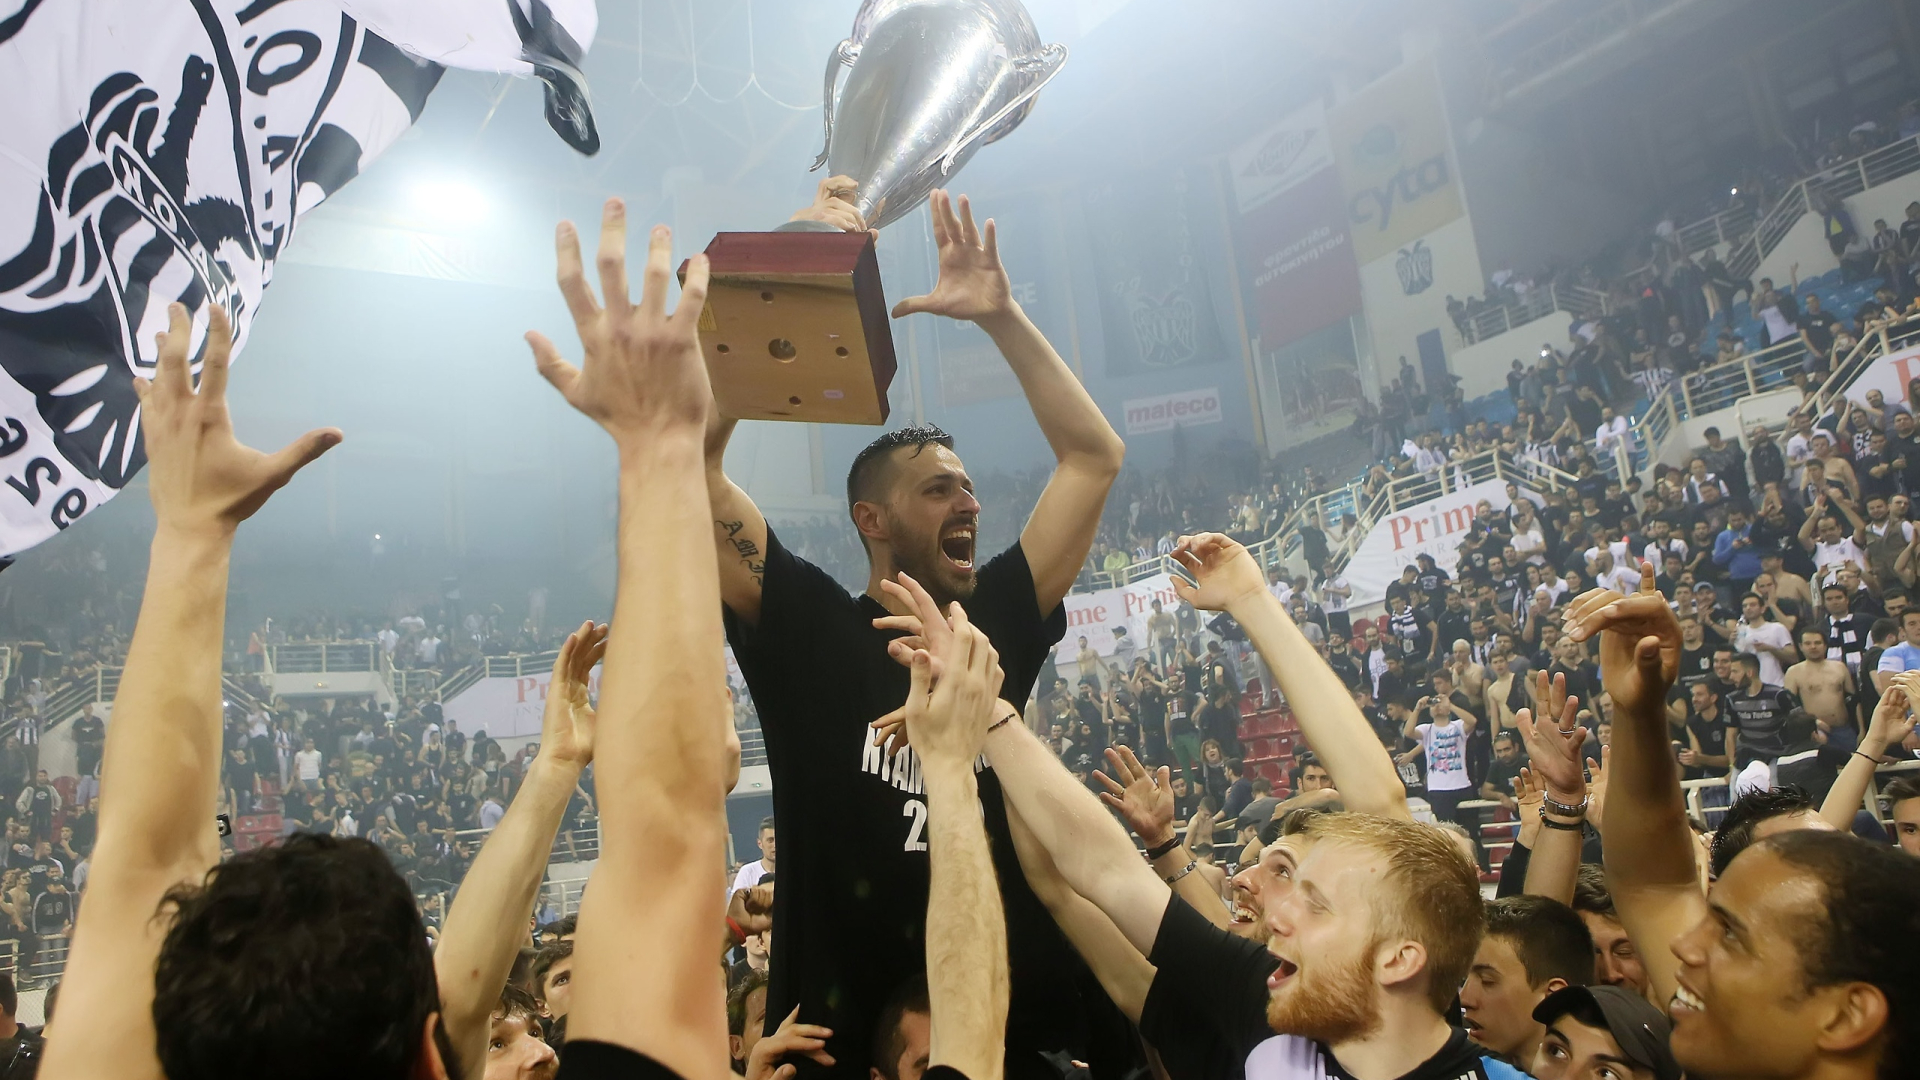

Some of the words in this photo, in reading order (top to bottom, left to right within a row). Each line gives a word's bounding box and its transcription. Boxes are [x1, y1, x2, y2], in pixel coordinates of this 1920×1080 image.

[1348, 153, 1449, 231] cyta
[1127, 396, 1218, 423] mateco
[1388, 504, 1478, 552] Prim
